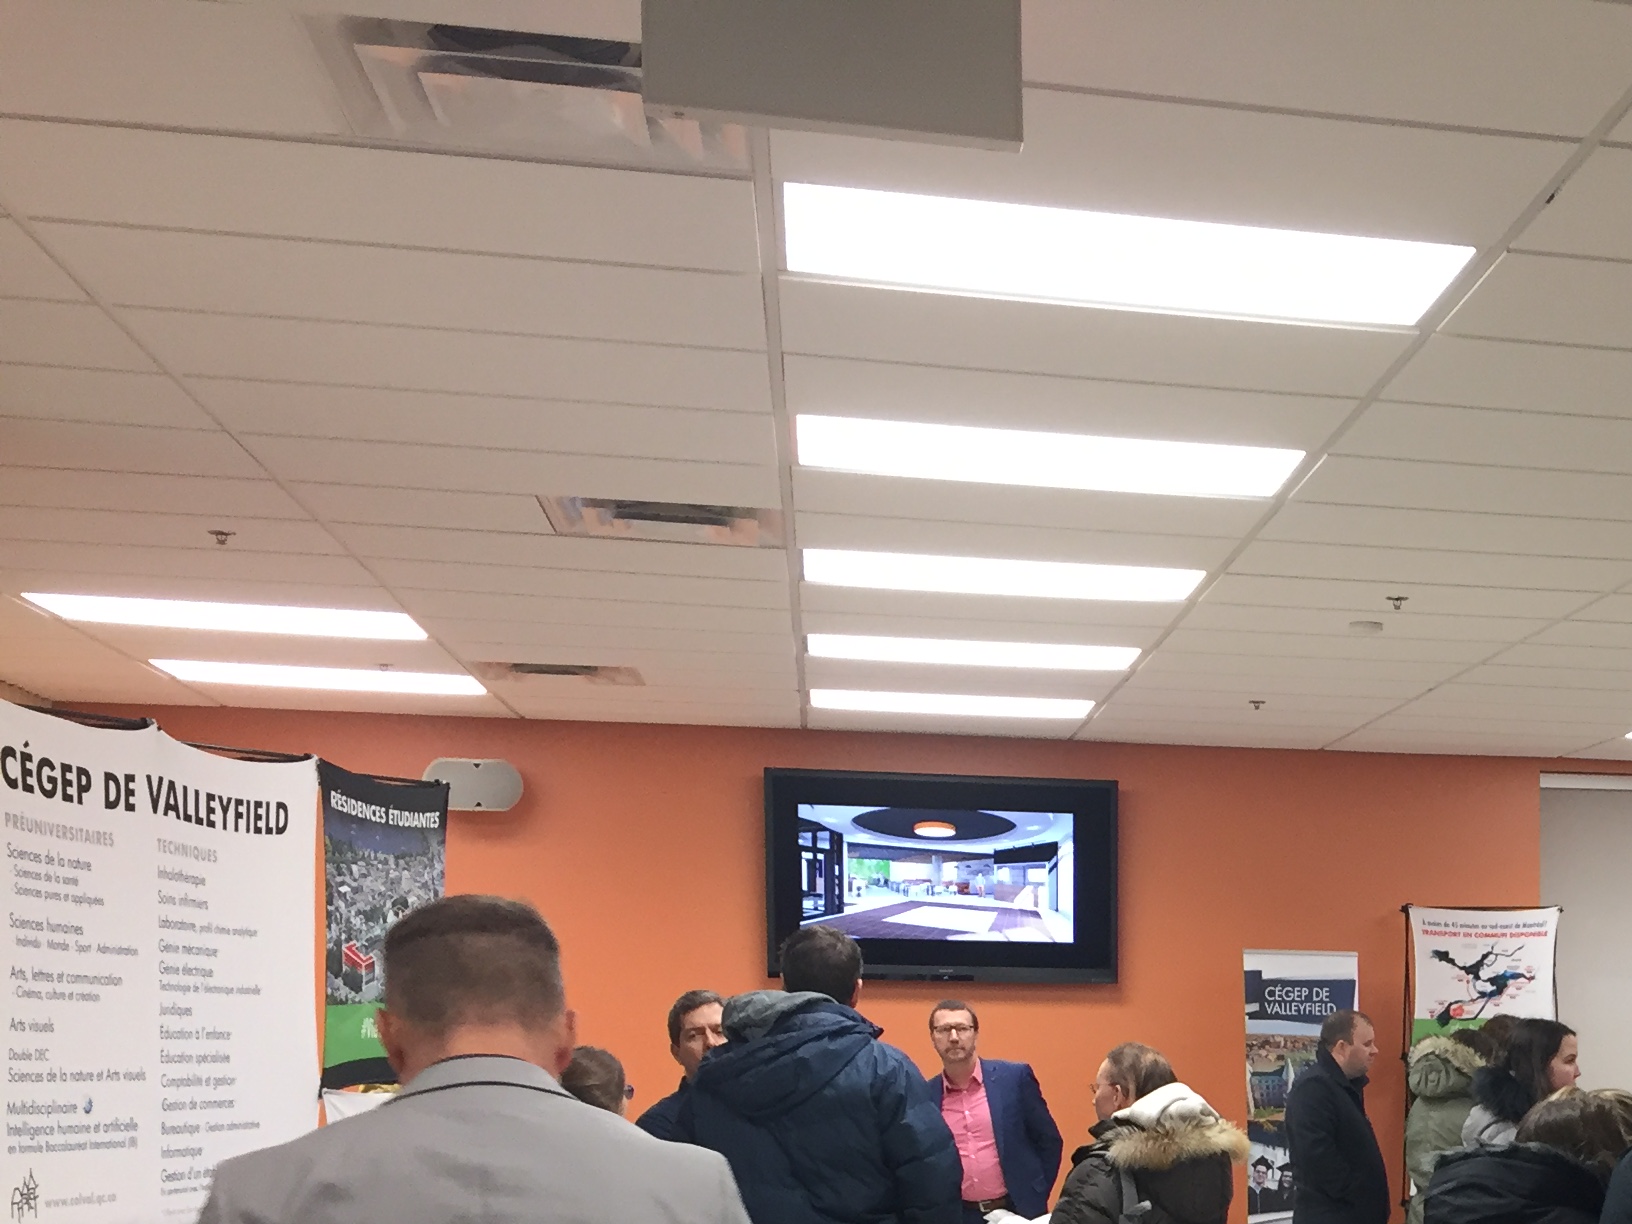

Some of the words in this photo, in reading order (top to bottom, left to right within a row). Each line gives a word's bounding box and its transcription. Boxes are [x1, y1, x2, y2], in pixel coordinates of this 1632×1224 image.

[1, 740, 92, 806] CÉGEP
[104, 771, 136, 812] DE
[146, 774, 289, 836] VALLEYFIELD
[330, 788, 387, 824] RÉSIDENCES
[388, 804, 440, 829] ÉTUDIANTES
[4, 811, 115, 848] PRÉUNIVERSITAIRES
[6, 842, 42, 864] Sciences
[44, 849, 55, 866] de
[57, 851, 66, 868] la
[67, 858, 92, 871] nature
[156, 838, 218, 863] TECHNIQUES
[9, 912, 44, 932] Sciences
[1264, 983, 1309, 1002] CÉGEP
[1312, 987, 1330, 1002] DE
[1264, 1002, 1337, 1016] VALLEYFIELD
[9, 1017, 26, 1032] Arts
[27, 1016, 55, 1033] visuels
[8, 1066, 44, 1083] Sciences
[46, 1067, 58, 1082] de
